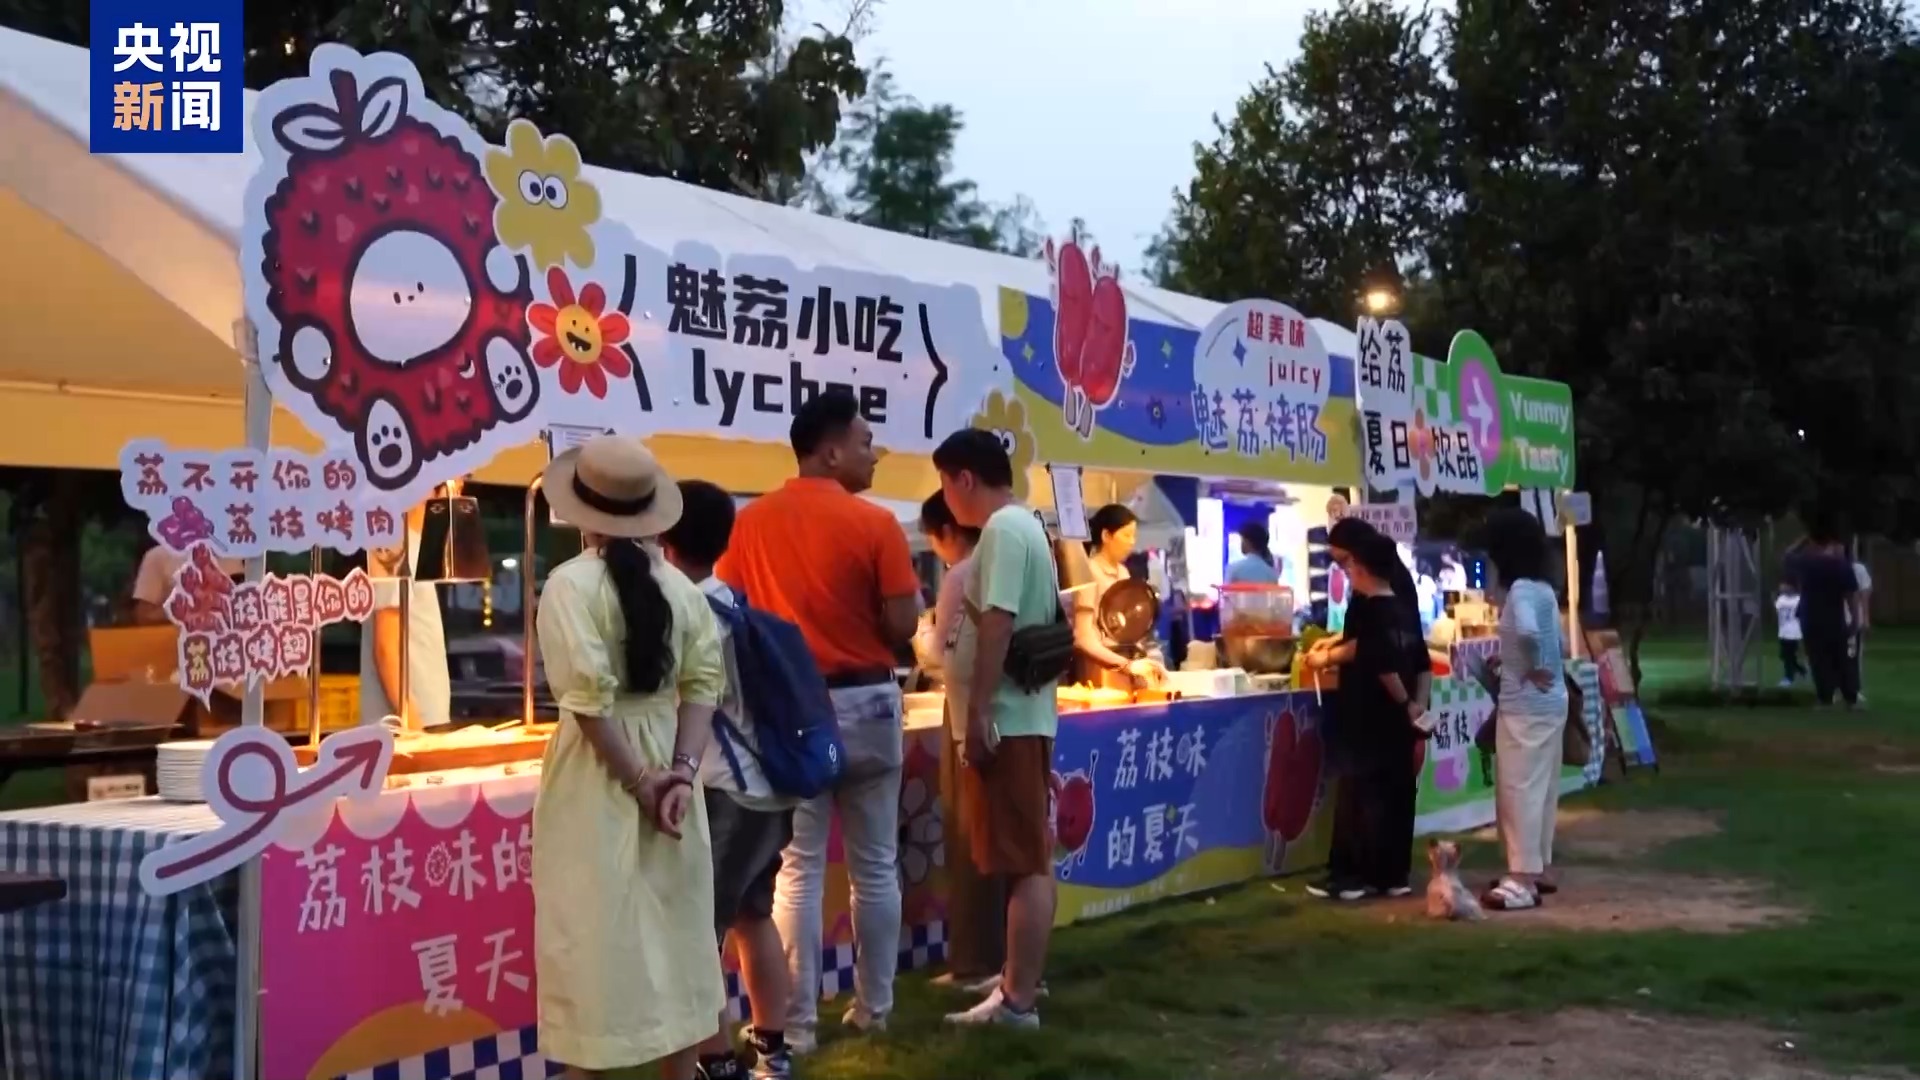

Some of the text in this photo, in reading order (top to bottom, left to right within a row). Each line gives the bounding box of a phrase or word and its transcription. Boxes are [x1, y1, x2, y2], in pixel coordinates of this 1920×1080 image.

[666, 262, 904, 362] 魅荔小吃
[1247, 309, 1305, 348] 超美味
[1268, 355, 1321, 393] juicy
[1360, 329, 1405, 394] 给荔
[1191, 383, 1327, 463] 魅荔烤肠
[1509, 391, 1569, 434] Yummy
[134, 452, 357, 495] 荔不开你的
[1364, 410, 1479, 483] 夏日饮品
[1512, 436, 1569, 484] Tasty
[225, 499, 394, 544] 荔枝烤肉
[1113, 725, 1207, 789] 荔枝味
[1107, 803, 1199, 869] 的夏天
[411, 927, 531, 1016] 夏天
